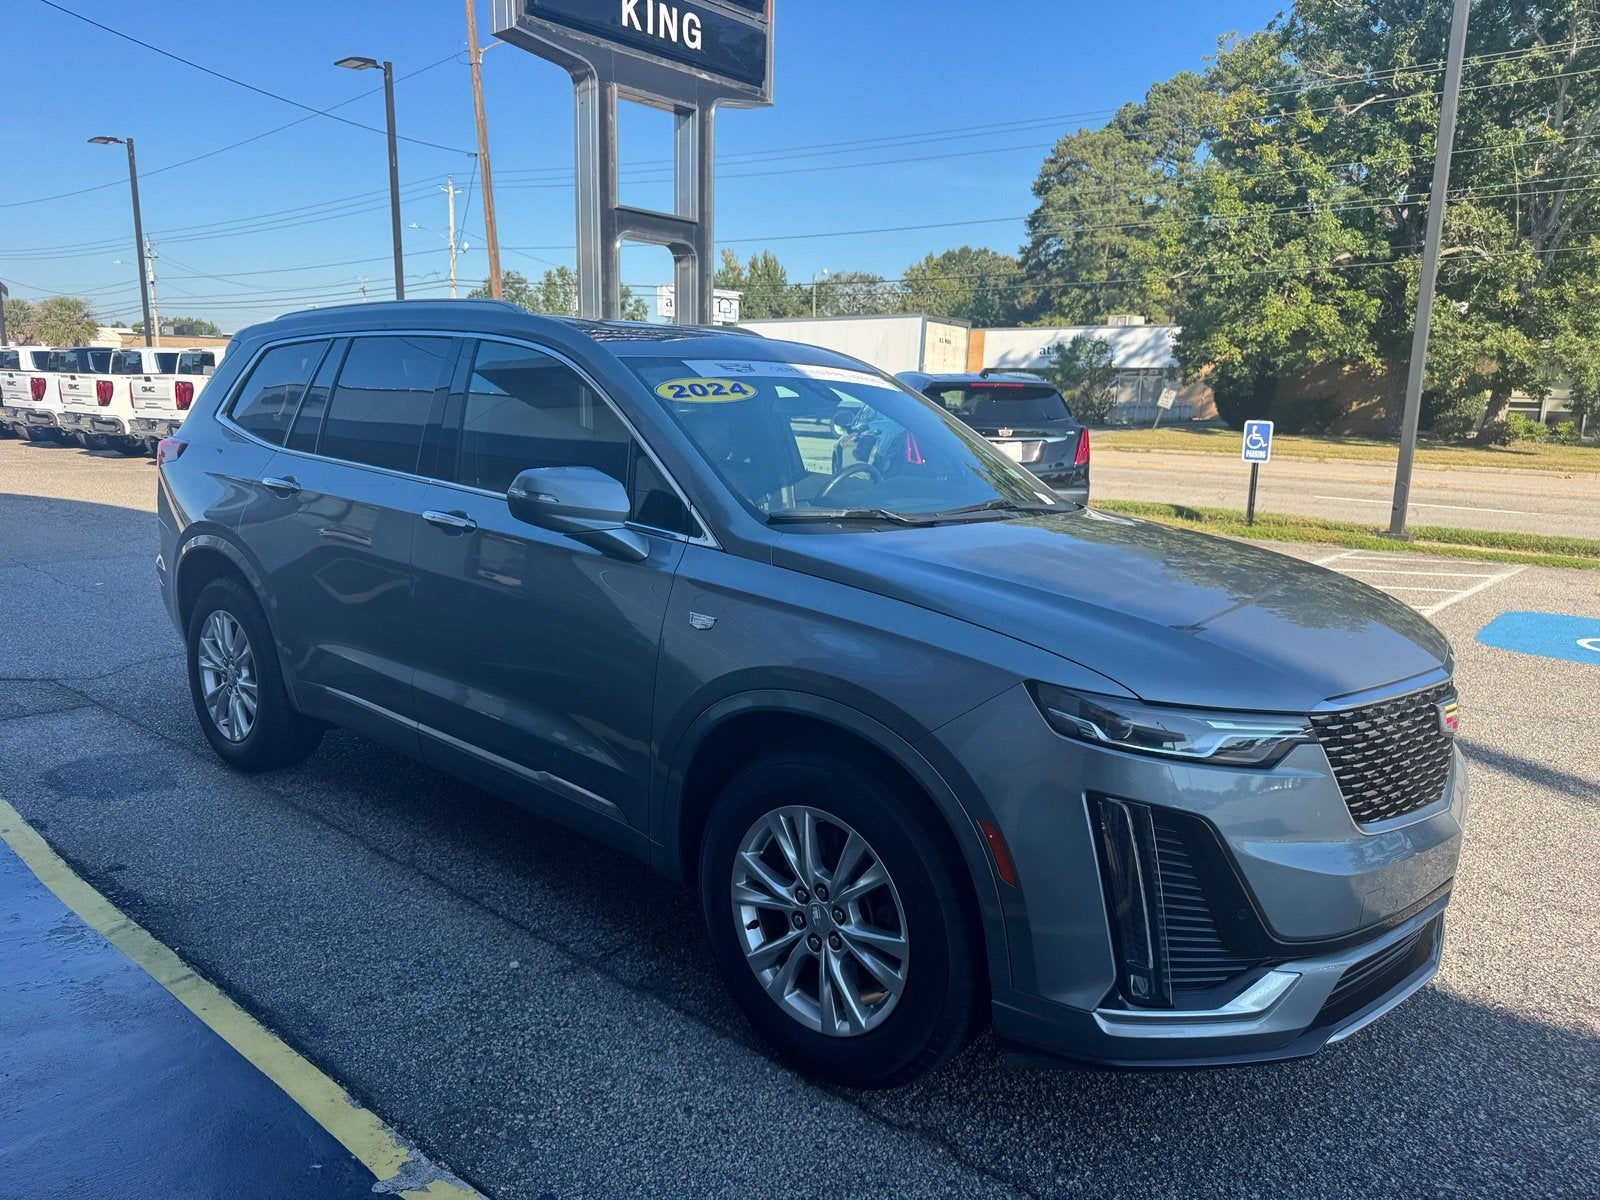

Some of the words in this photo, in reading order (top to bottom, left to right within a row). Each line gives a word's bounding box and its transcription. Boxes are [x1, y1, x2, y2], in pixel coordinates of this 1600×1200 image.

[621, 0, 702, 50] KING
[668, 382, 749, 399] 2024
[1245, 450, 1267, 459] PARKING
